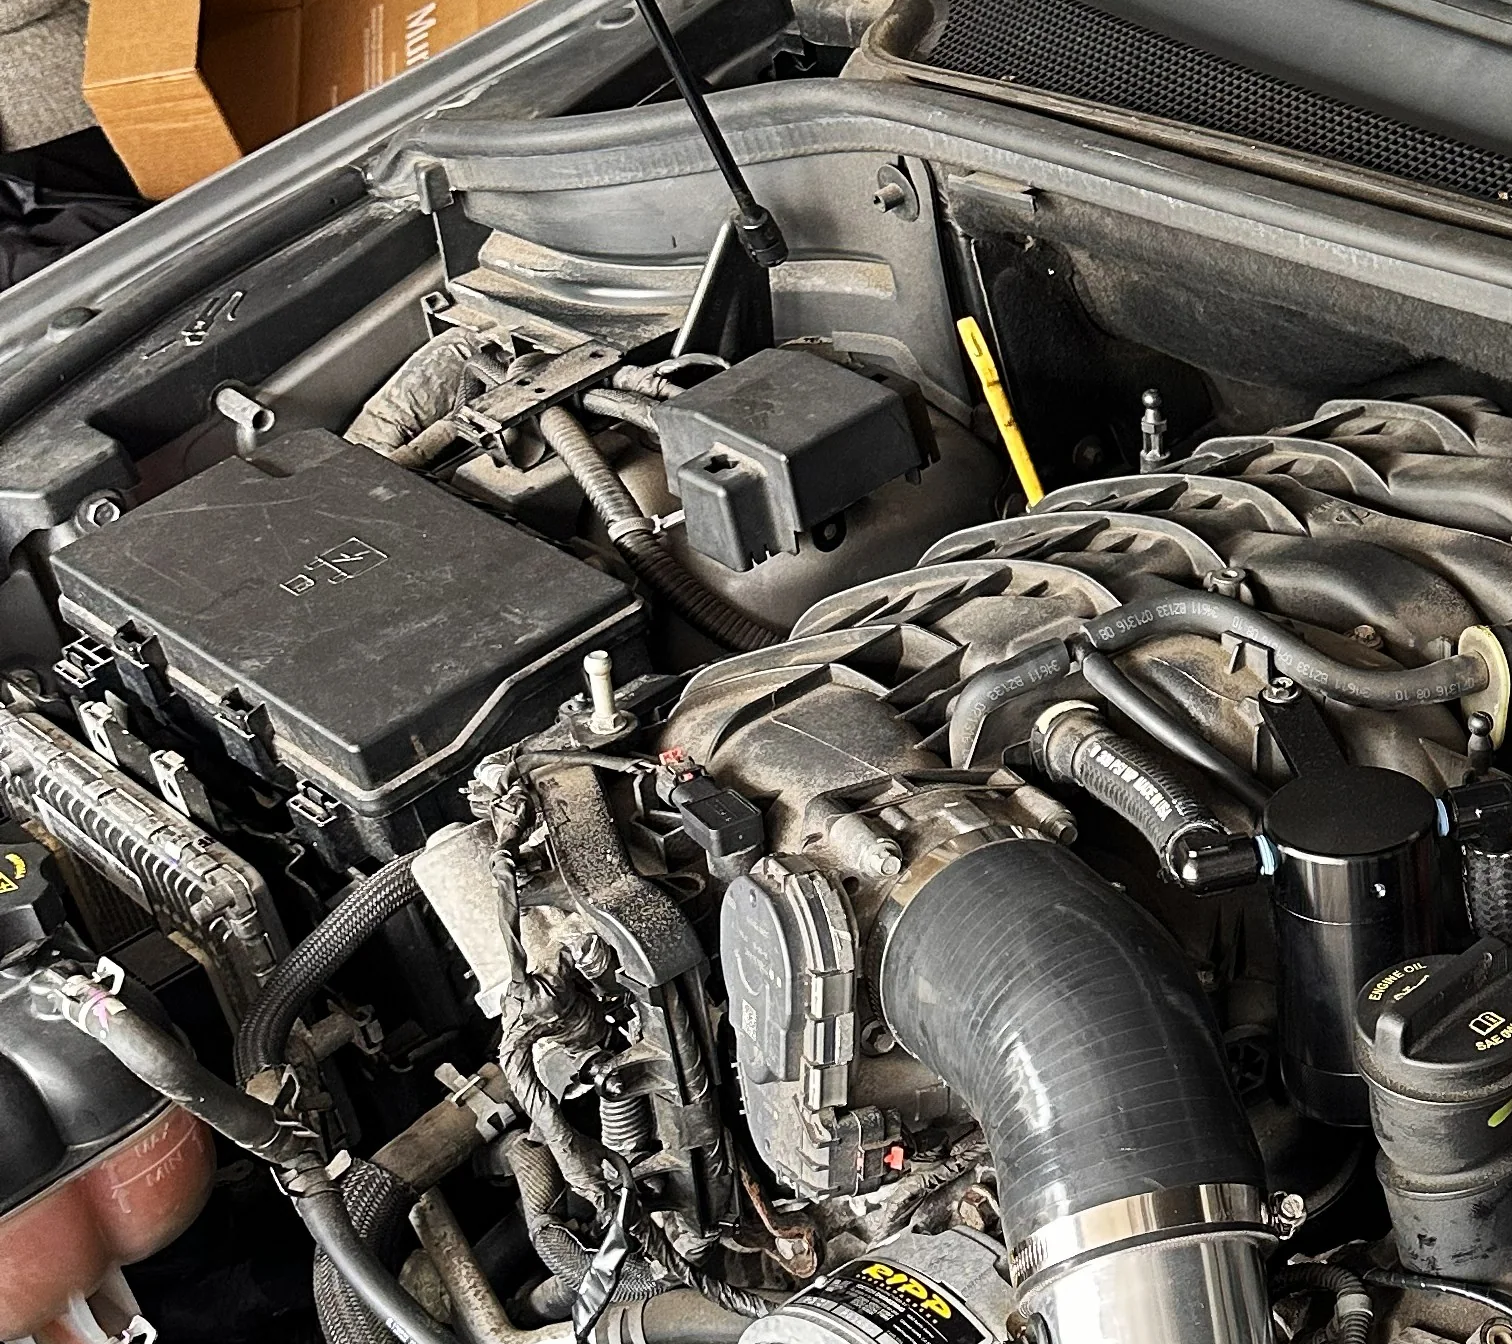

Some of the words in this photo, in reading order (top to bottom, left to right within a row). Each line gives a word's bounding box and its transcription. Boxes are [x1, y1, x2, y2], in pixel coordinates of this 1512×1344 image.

[1115, 608, 1153, 632] 071316
[1027, 658, 1061, 682] 34611
[985, 674, 1024, 701] BZ133
[1107, 758, 1128, 776] PSI
[1132, 775, 1158, 800] MADE
[1148, 791, 1164, 807] IN
[1154, 799, 1172, 821] USA
[1367, 968, 1405, 1003] ENGINE
[1403, 961, 1427, 974] OIL
[1474, 1033, 1504, 1050] SAE
[862, 1263, 952, 1319] RIPP
